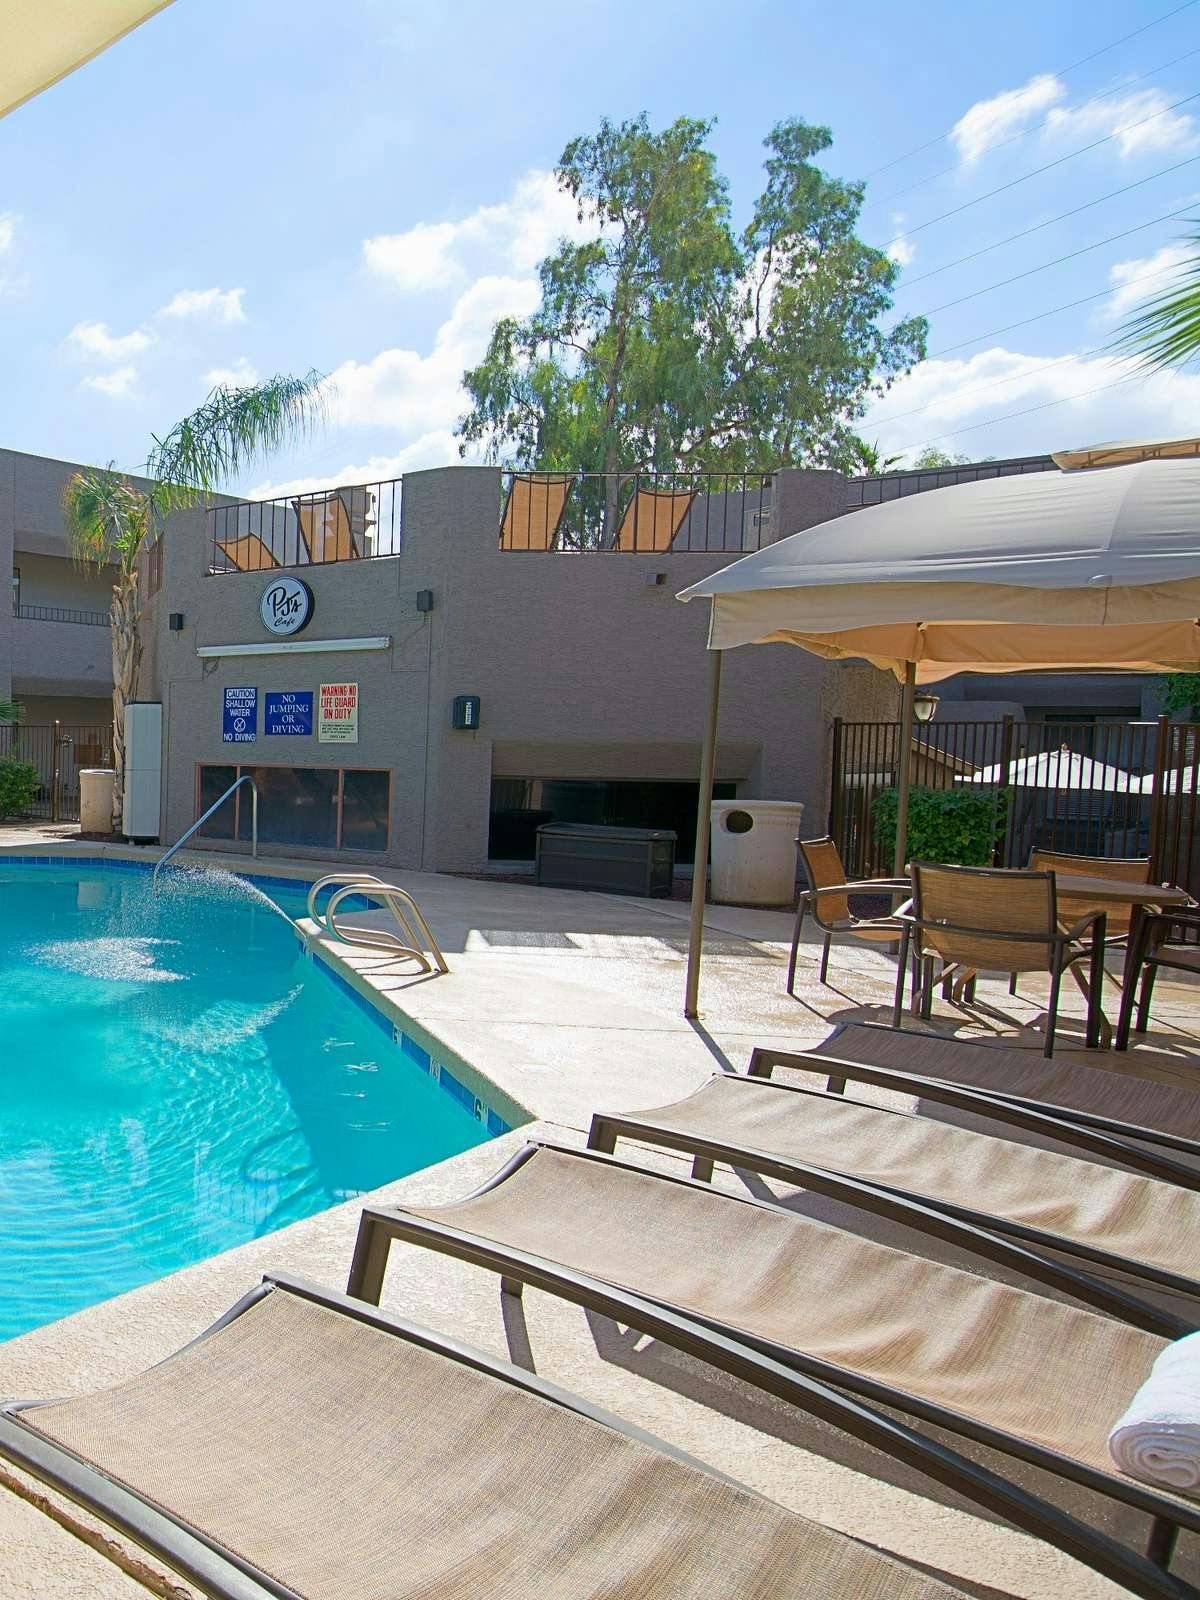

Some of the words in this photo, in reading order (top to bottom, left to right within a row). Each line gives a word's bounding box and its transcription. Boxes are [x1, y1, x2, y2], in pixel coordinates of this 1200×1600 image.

[227, 690, 255, 698] CAUTION
[321, 686, 348, 697] WARNING
[349, 685, 356, 696] NO
[282, 695, 296, 703] NO
[321, 697, 333, 708] LIFE
[335, 697, 356, 707] GUARD
[226, 700, 255, 708] SHALLOW
[230, 709, 251, 717] WATER
[269, 705, 309, 714] JUMPING
[324, 709, 333, 719] ON
[335, 708, 352, 719] DUTY
[281, 715, 295, 723] OR
[272, 725, 304, 733] DIVING
[475, 1099, 482, 1121] 6
